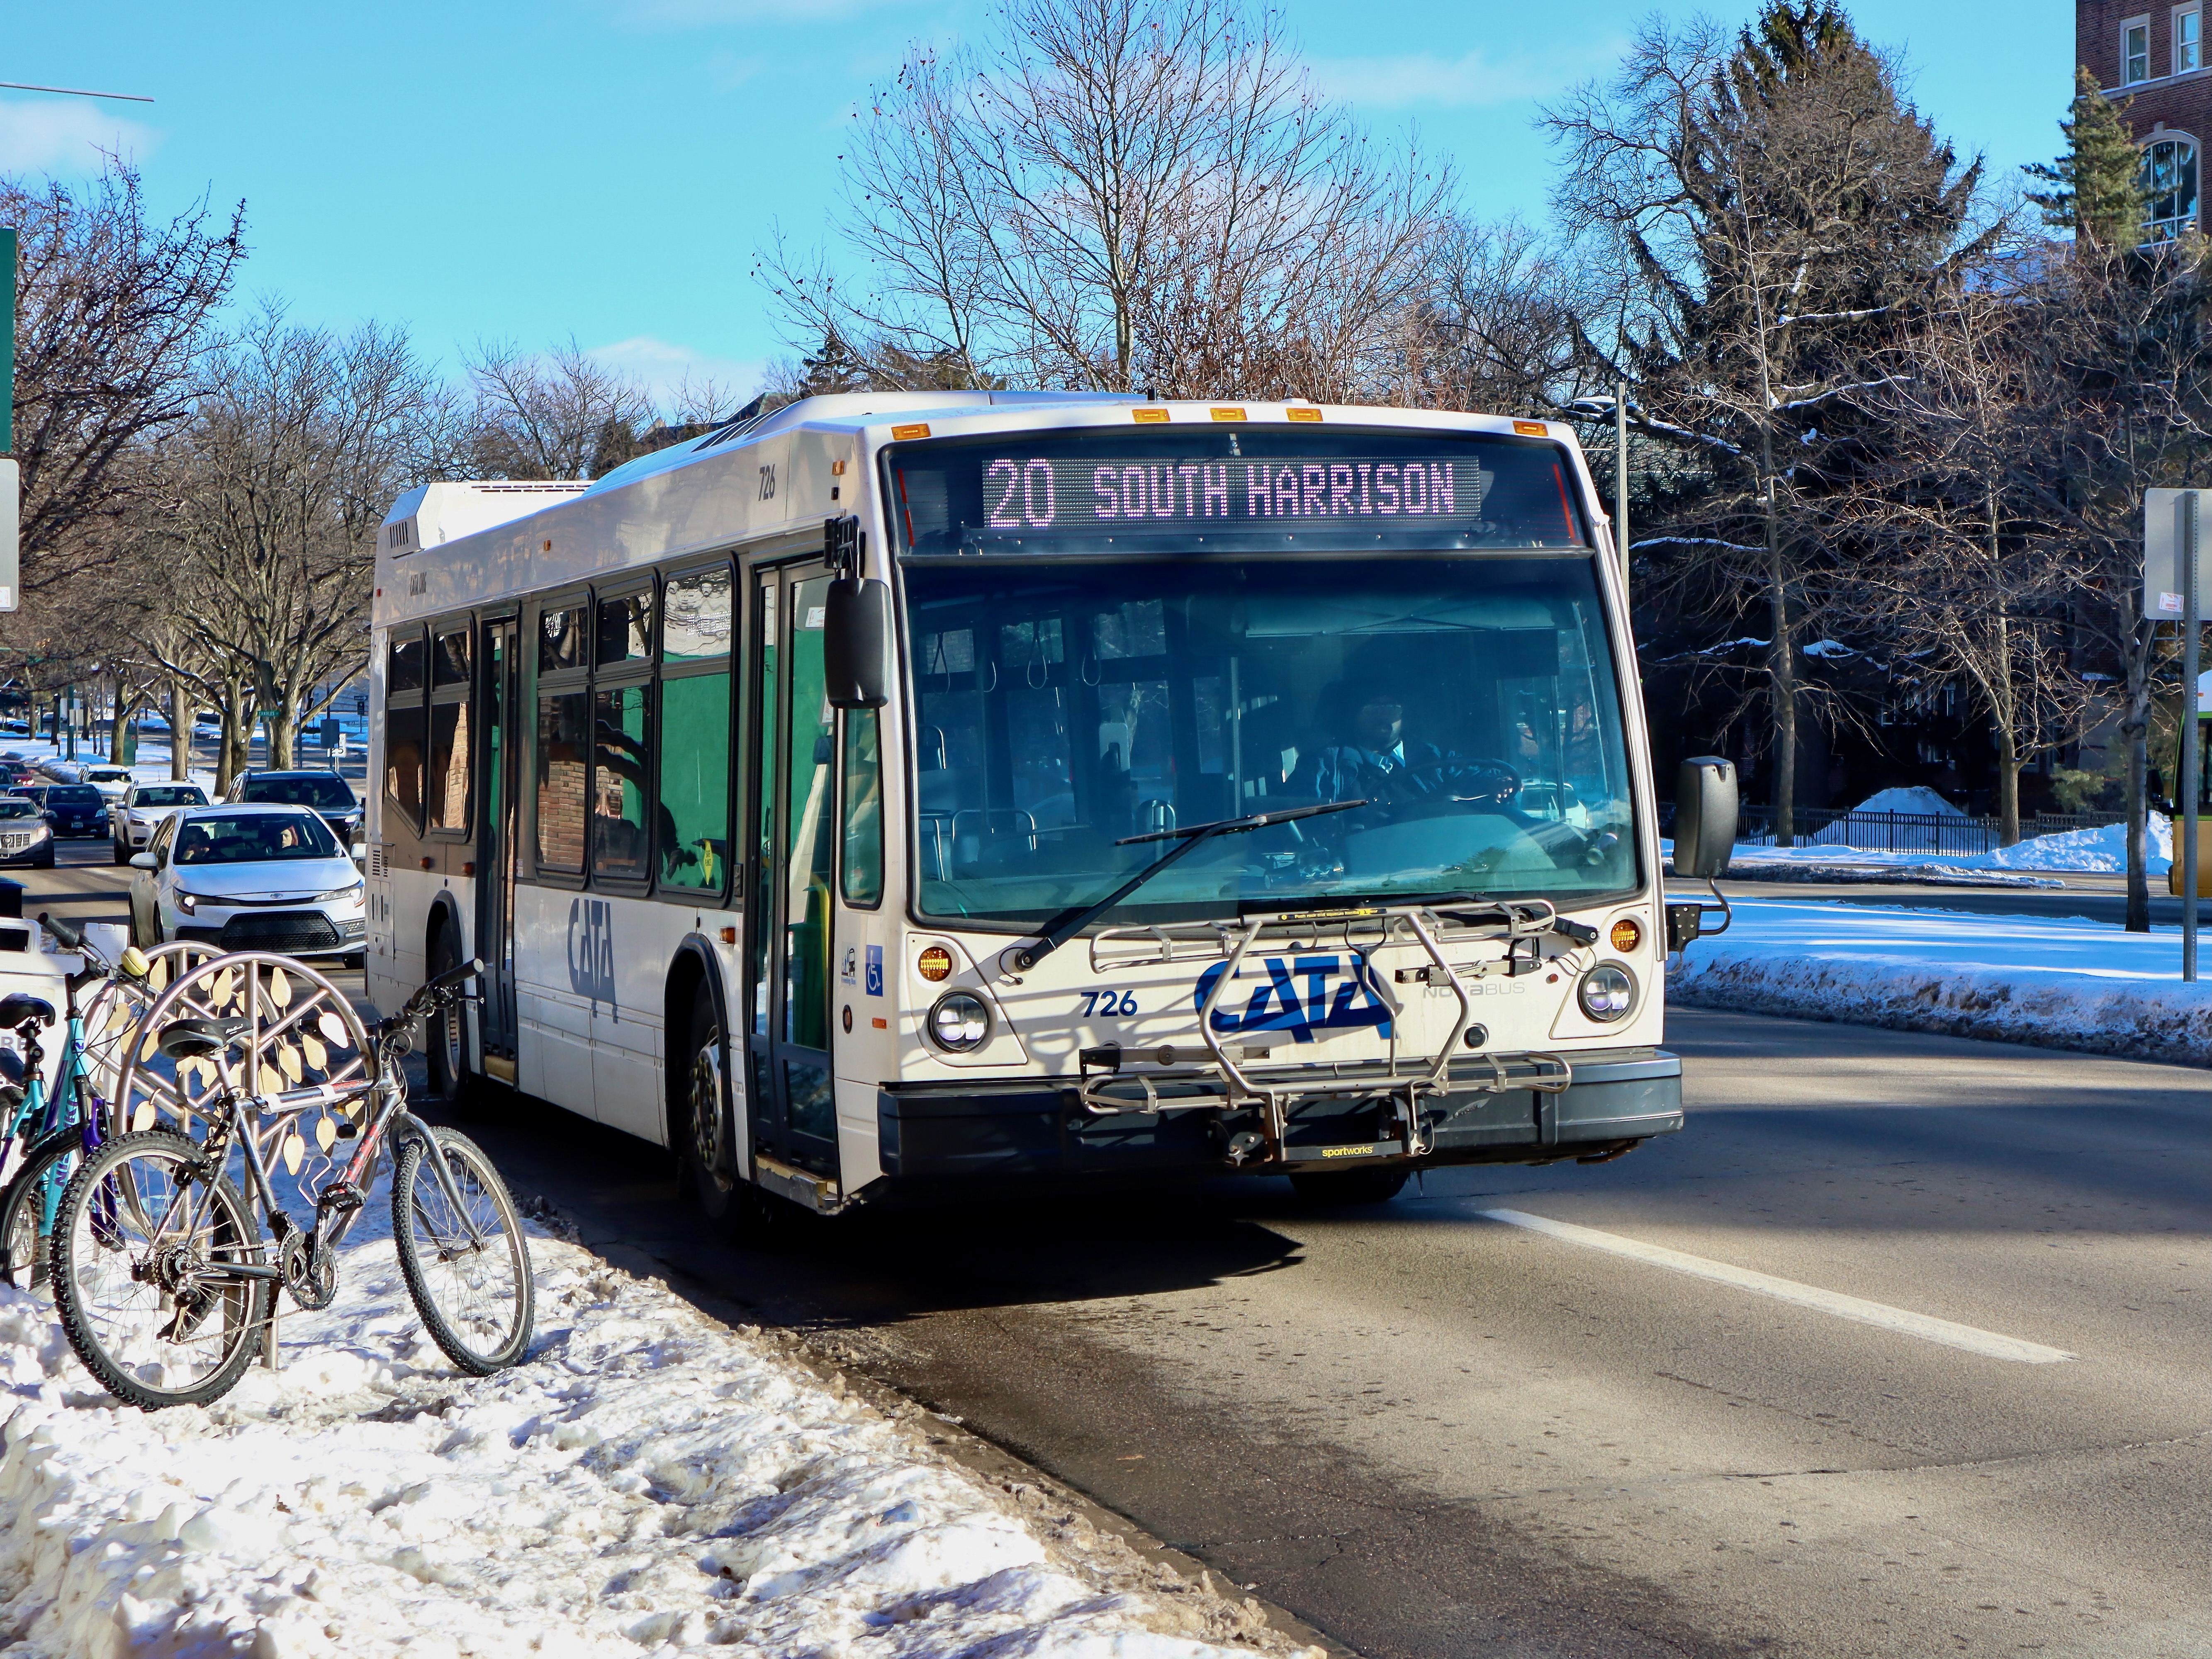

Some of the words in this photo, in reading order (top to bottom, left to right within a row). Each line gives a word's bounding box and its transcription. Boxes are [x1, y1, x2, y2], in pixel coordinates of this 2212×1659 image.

[758, 464, 775, 501] 726
[988, 459, 1054, 528] 20
[1094, 465, 1227, 518] SOUTH
[1247, 463, 1455, 516] HARRISON
[567, 898, 618, 1024] CATA
[1080, 990, 1137, 1018] 726
[1194, 955, 1399, 1043] CATA
[1322, 1146, 1373, 1158] sportworks
